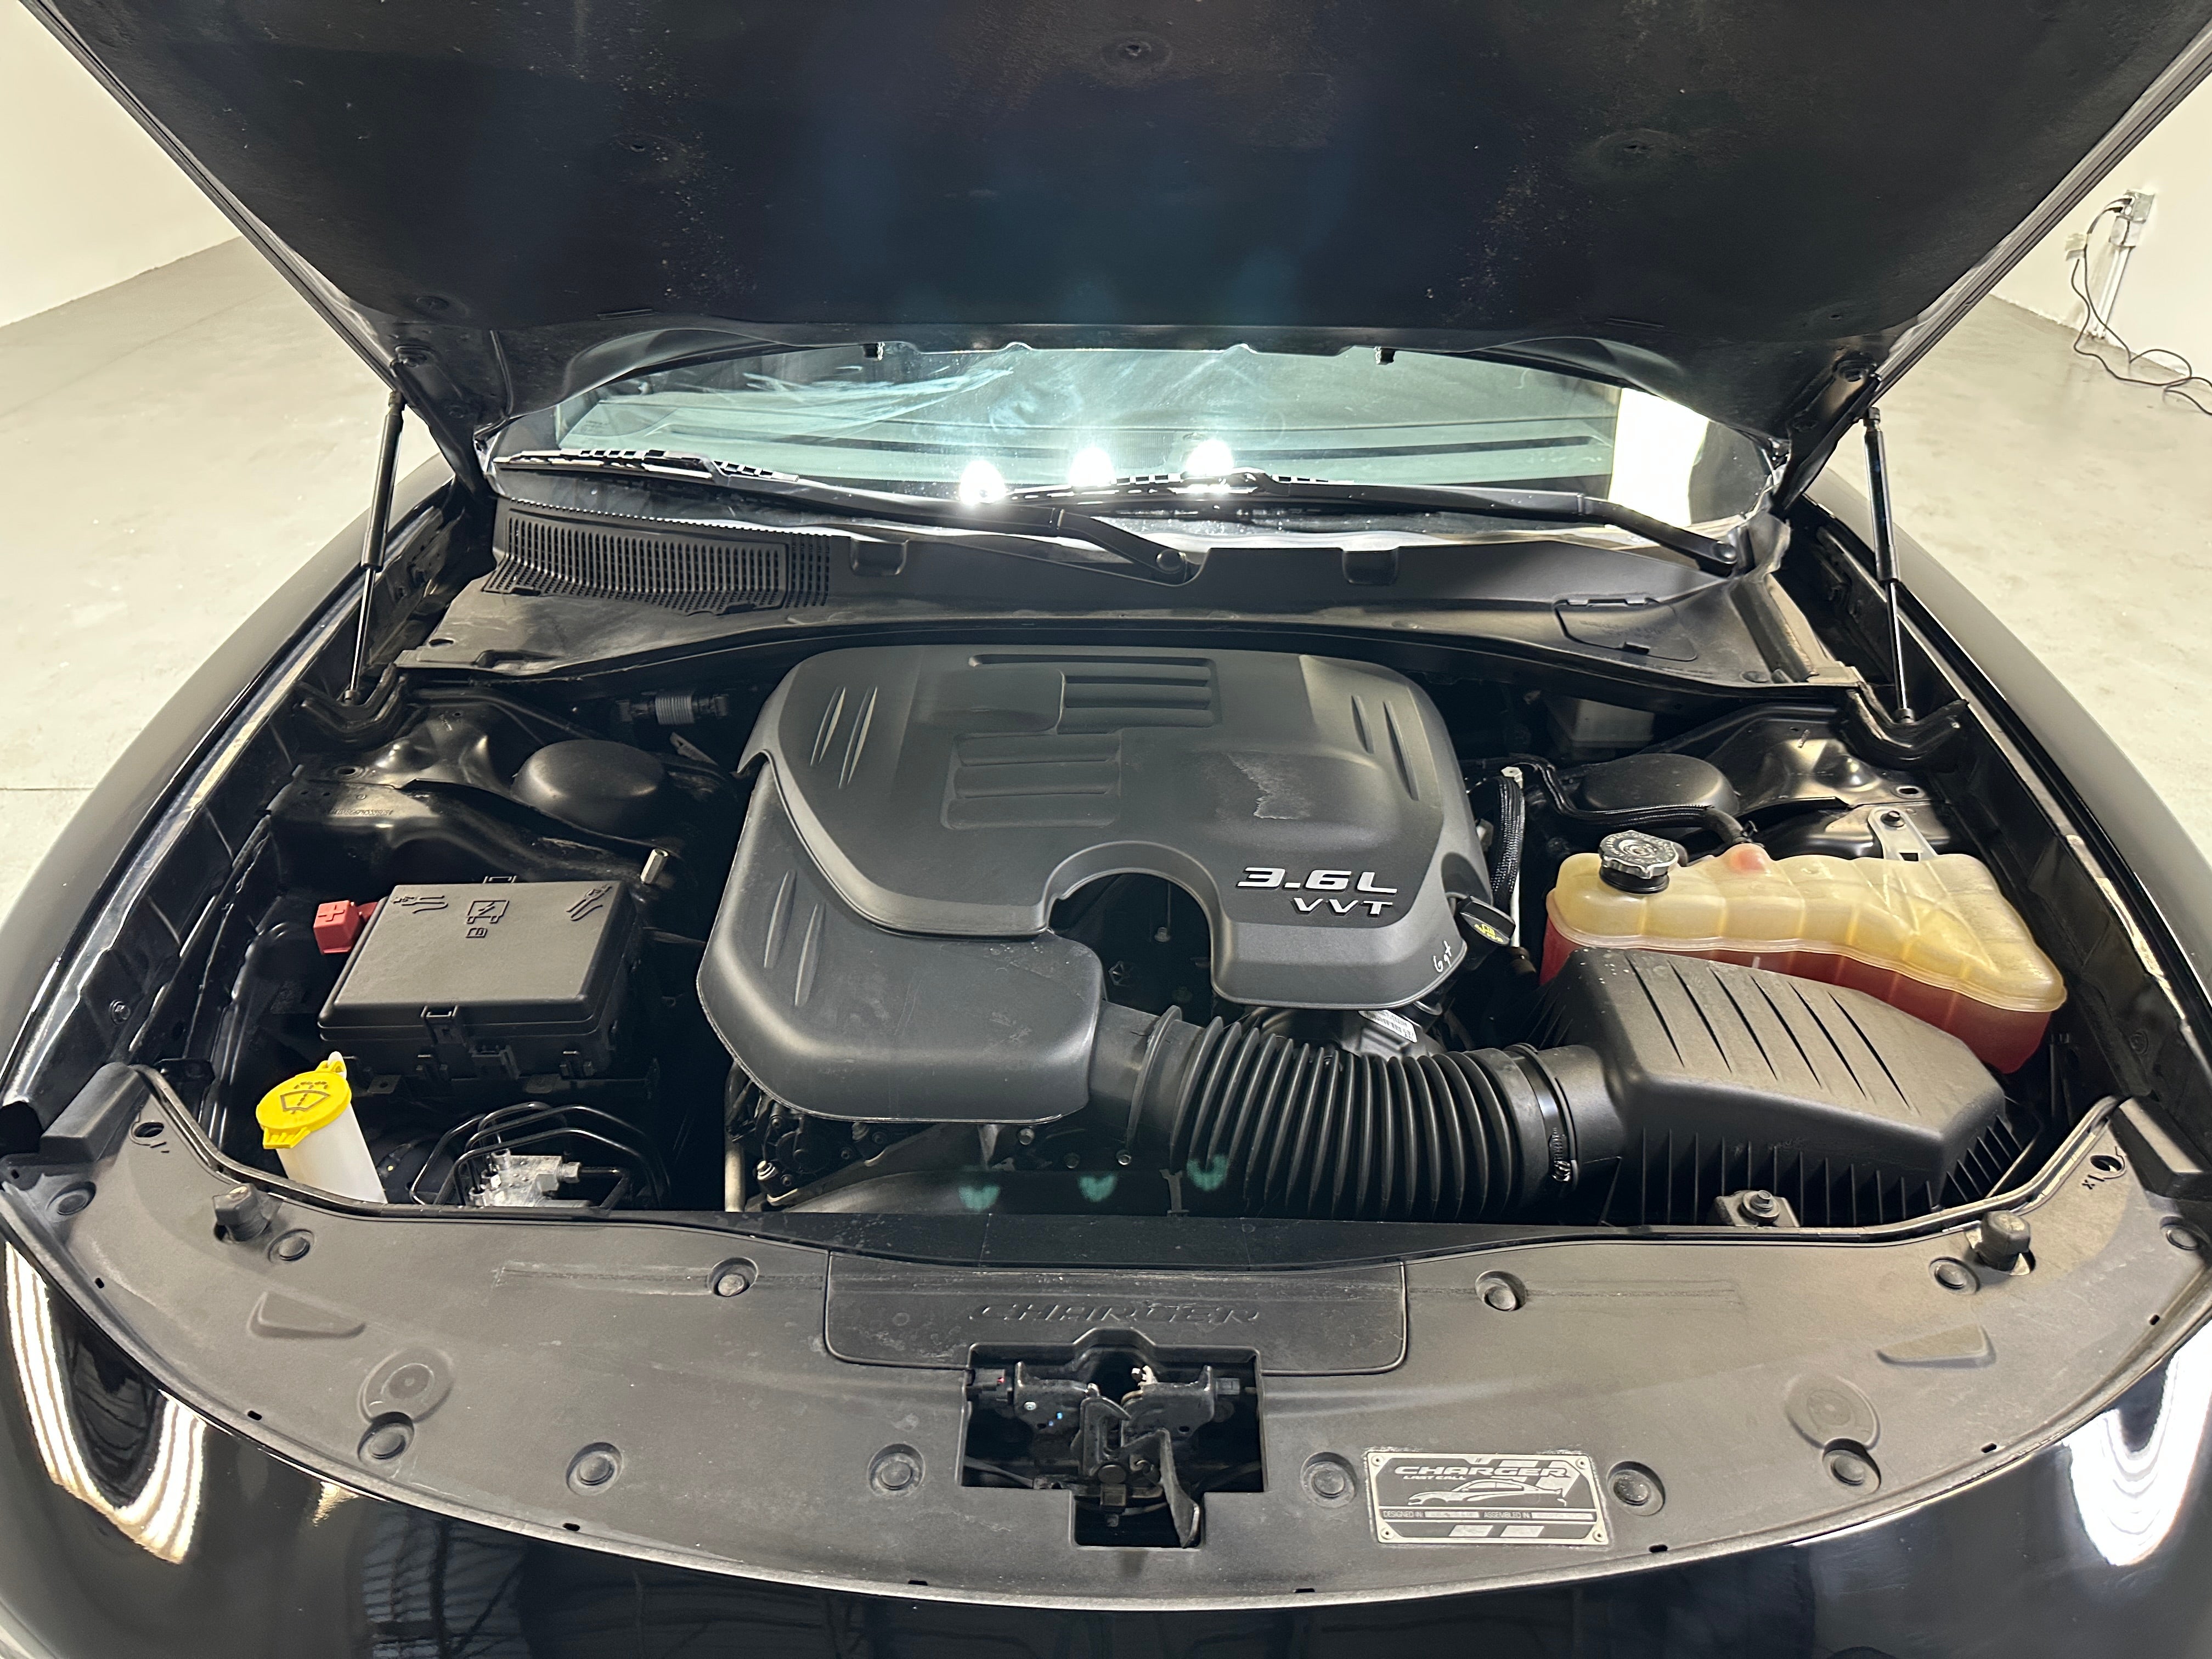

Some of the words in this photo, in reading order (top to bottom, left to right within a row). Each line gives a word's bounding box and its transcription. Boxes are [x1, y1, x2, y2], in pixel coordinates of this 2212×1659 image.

[1236, 866, 1398, 894] 3.6L
[1293, 896, 1393, 916] VVT
[968, 1302, 1259, 1324] CHARGER
[1394, 1466, 1571, 1478] CHARGER
